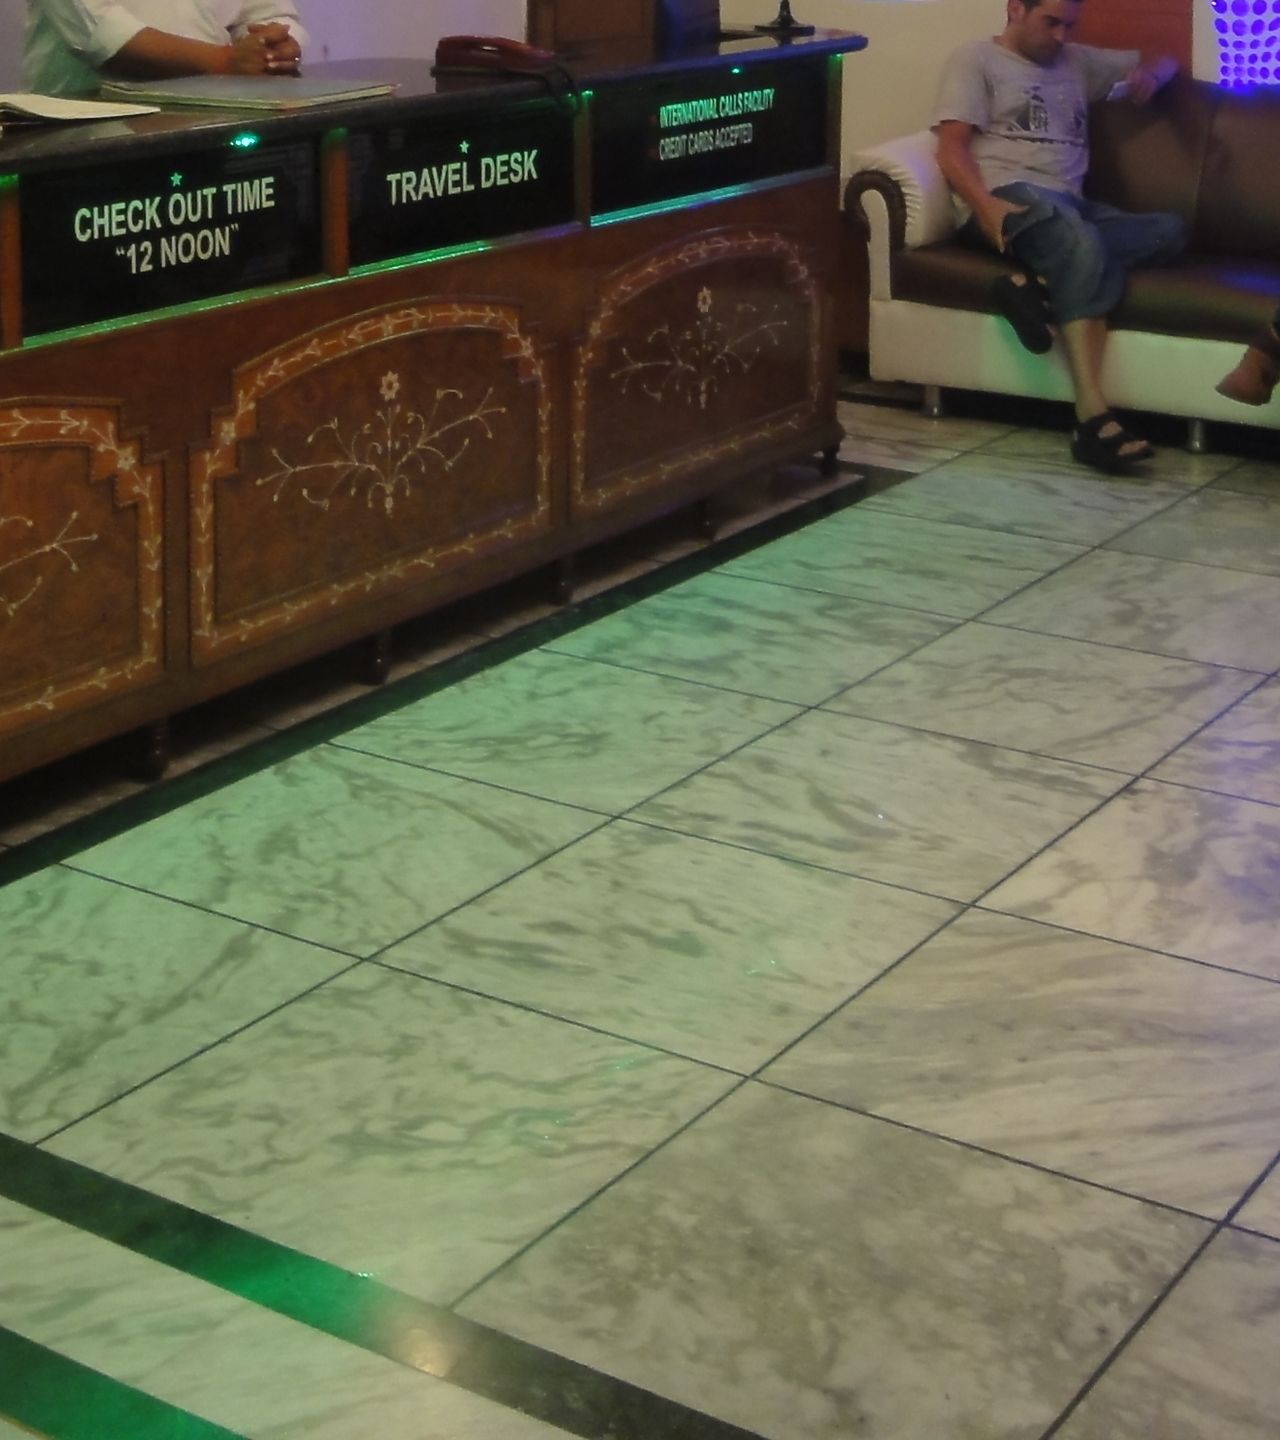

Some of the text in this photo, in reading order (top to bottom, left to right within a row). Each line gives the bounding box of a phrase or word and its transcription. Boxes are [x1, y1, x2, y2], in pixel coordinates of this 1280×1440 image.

[660, 88, 775, 128] INTERNATIONAL CALLS FACILITY
[660, 134, 687, 161] CREDIT
[688, 129, 714, 155] CARDS
[386, 149, 538, 206] TRAVEL DESK
[74, 177, 275, 242] CHECK OUT TIME
